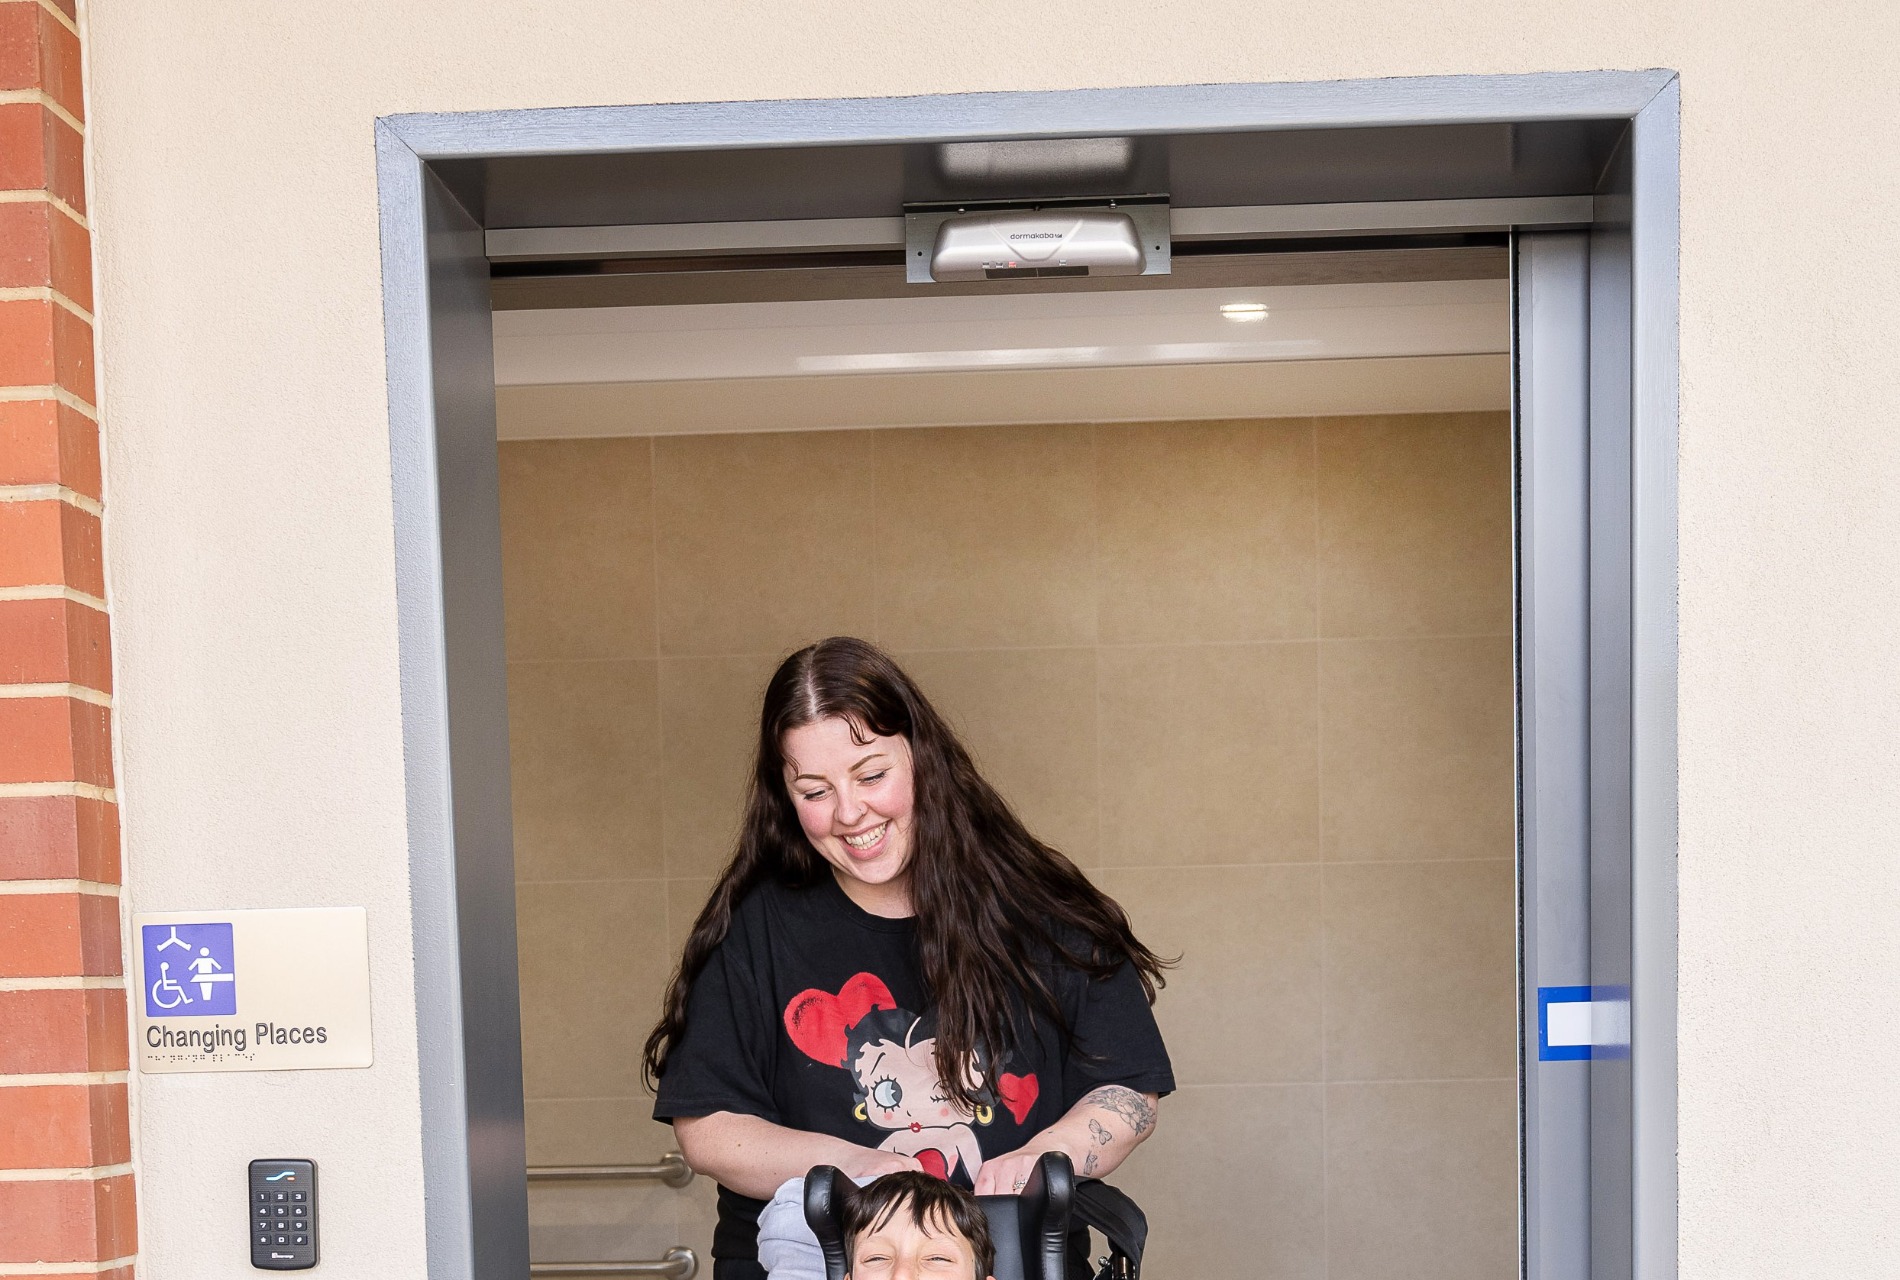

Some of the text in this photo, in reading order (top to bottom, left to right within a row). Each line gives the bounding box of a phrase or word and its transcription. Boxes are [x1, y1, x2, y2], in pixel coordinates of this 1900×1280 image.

[1010, 232, 1055, 240] dormakaba
[146, 1022, 328, 1053] Changing Places
